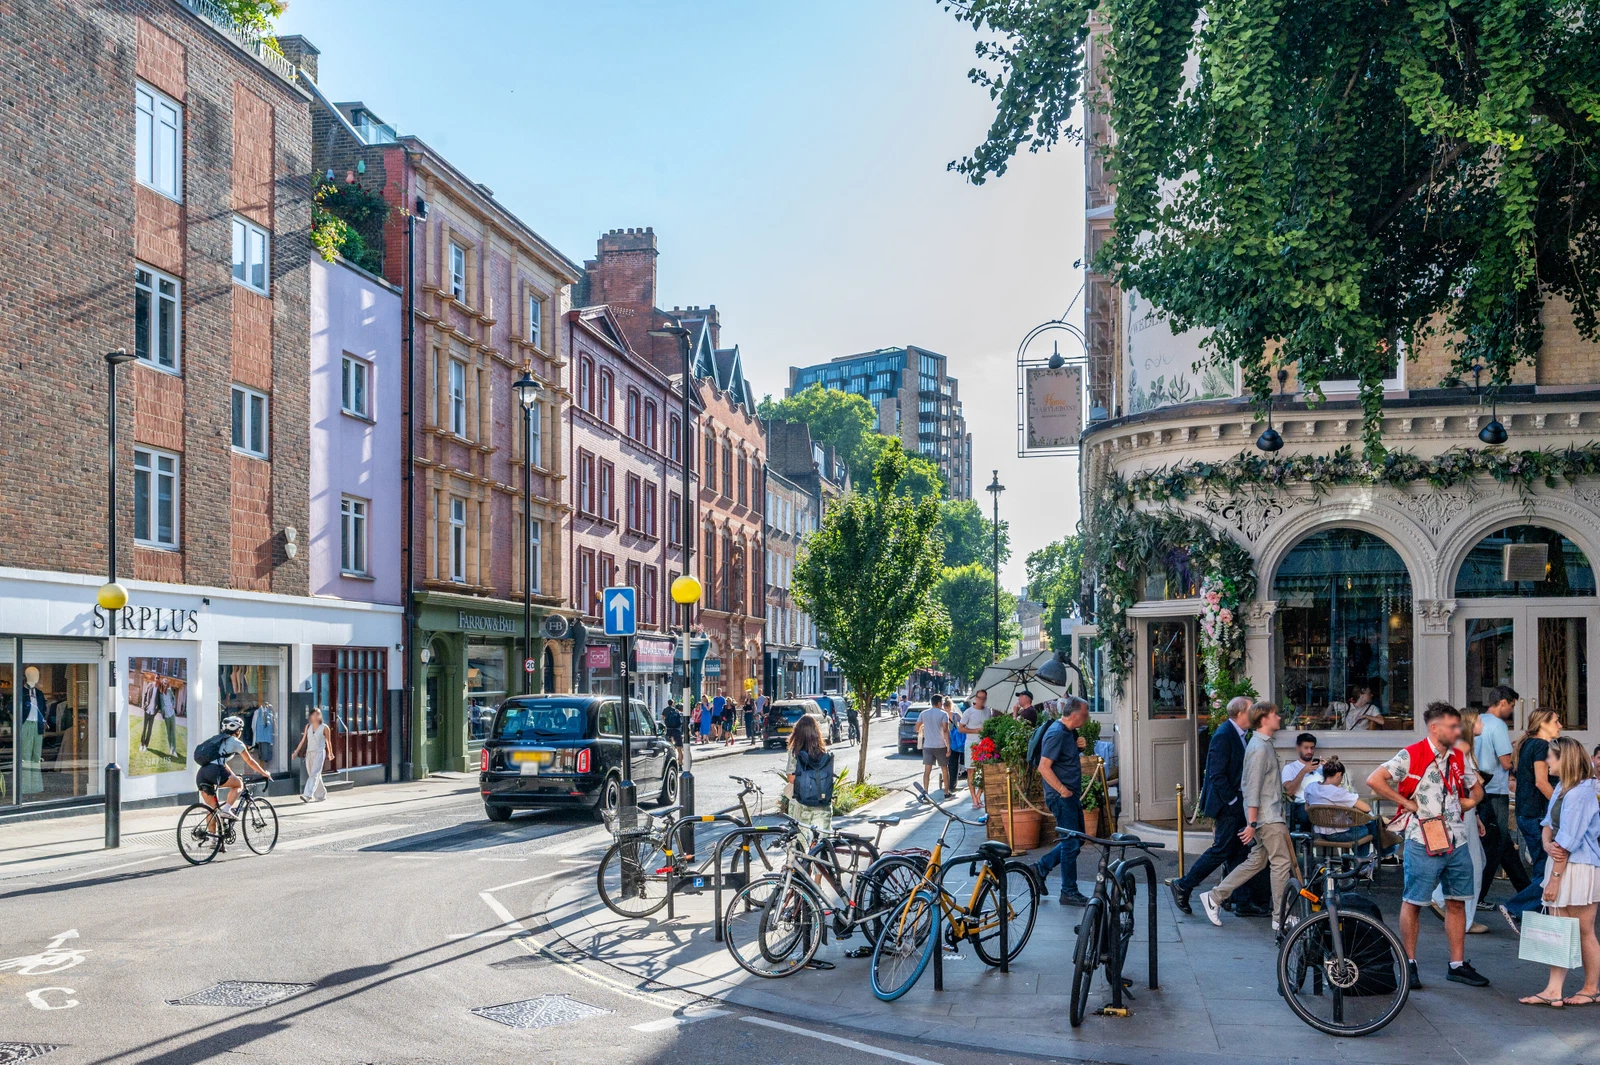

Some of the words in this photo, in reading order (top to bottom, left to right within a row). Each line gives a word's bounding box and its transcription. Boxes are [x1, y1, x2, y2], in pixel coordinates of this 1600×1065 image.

[1042, 392, 1066, 408] Home
[1032, 404, 1078, 414] MARYLEBONE
[92, 603, 199, 634] SRPLUS
[695, 878, 702, 886] P
